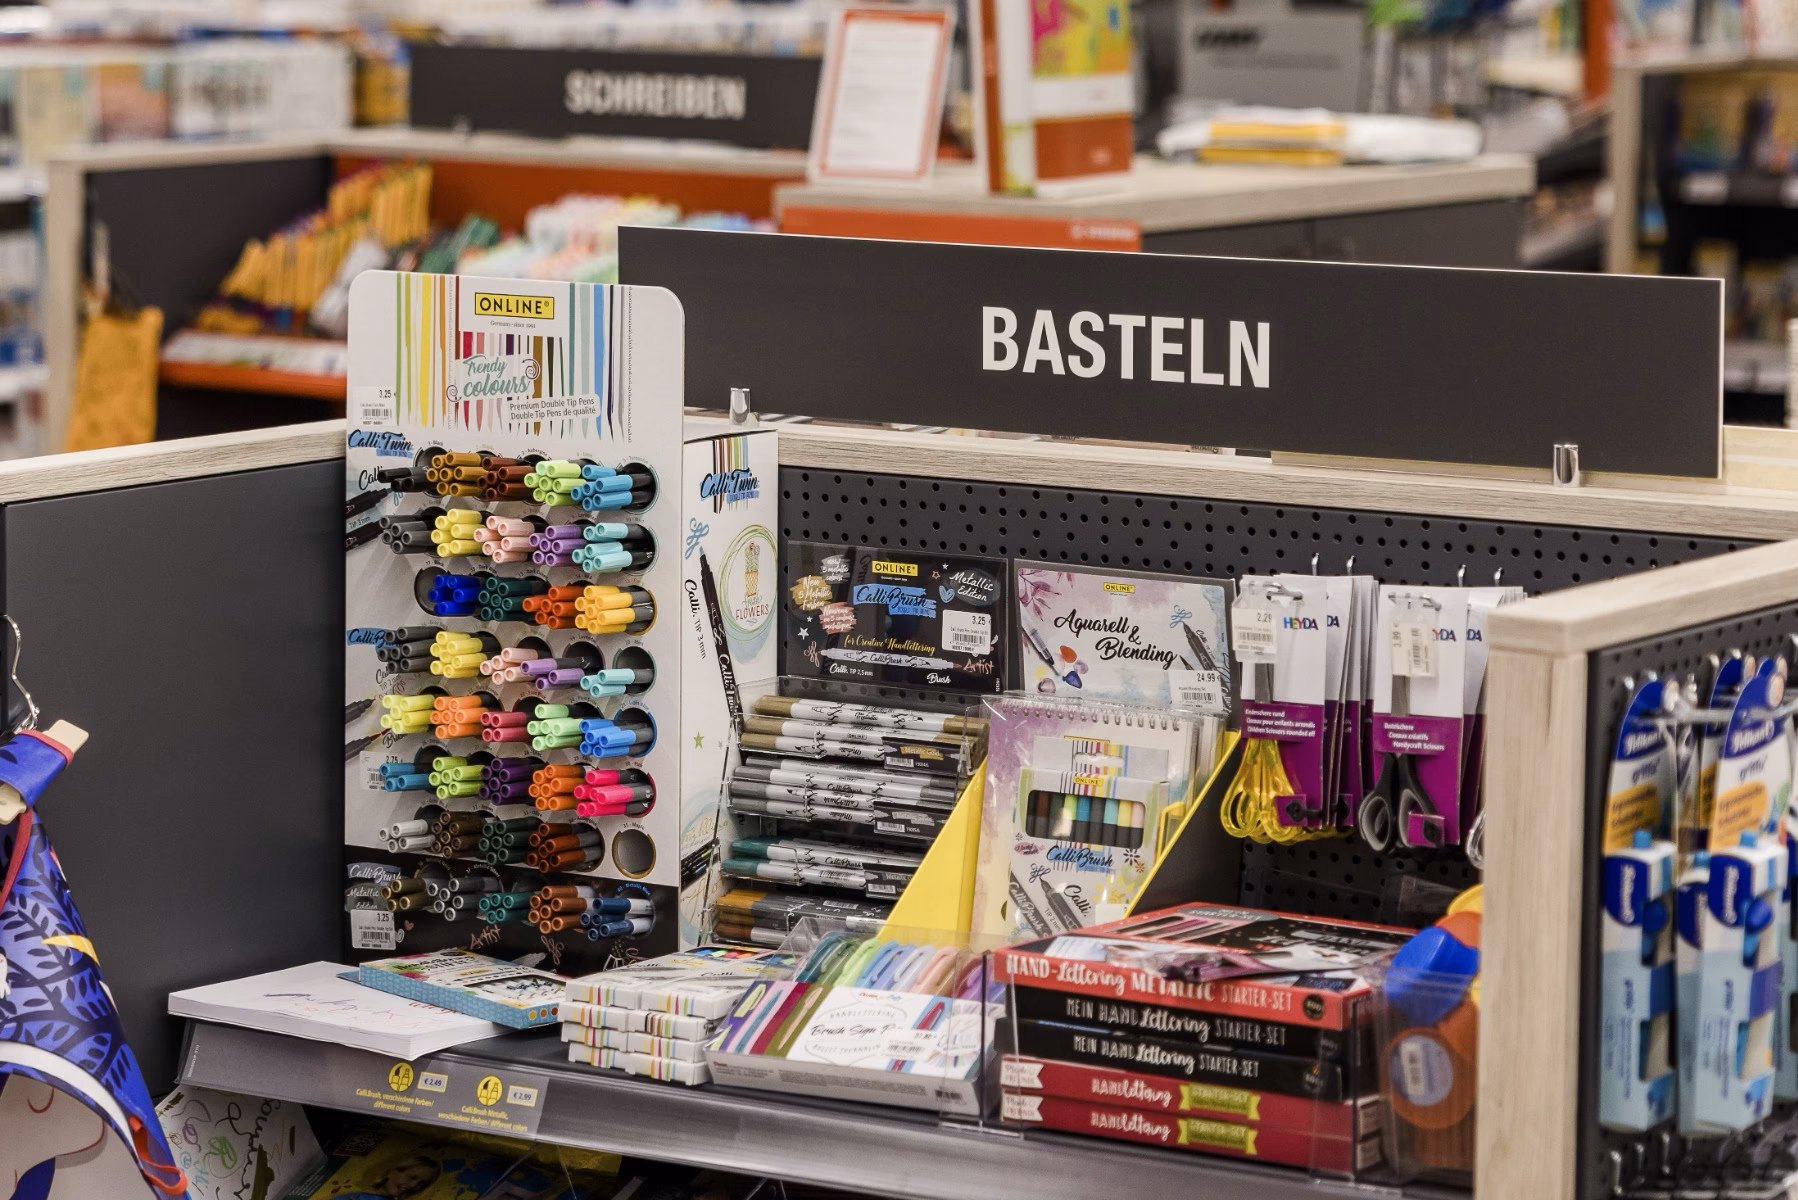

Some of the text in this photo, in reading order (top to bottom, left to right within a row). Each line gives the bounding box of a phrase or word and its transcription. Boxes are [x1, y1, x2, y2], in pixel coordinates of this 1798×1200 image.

[564, 69, 747, 121] SCHREIBEN
[982, 306, 1270, 389] BASTELN
[463, 354, 507, 378] Trendy
[463, 374, 530, 398] colours
[509, 397, 595, 411] Premium Double Tip Pens
[510, 406, 597, 421] Double Tip Pens de qualité
[802, 575, 820, 589] New
[949, 571, 994, 591] Metallic
[957, 585, 987, 602] Edition
[735, 604, 769, 621] FLOWERS
[694, 618, 702, 633] TIP
[972, 616, 986, 626] 3.25
[1054, 608, 1142, 645] Aquarell &
[1283, 616, 1319, 630] HEYDA
[844, 634, 855, 648] for
[856, 634, 884, 648] Creative
[884, 637, 936, 657] Handlettering
[1095, 636, 1178, 670] Blending
[963, 658, 995, 675] Artist
[926, 673, 951, 685] Brush
[1197, 672, 1216, 682] 24.99
[1274, 719, 1294, 728] enfants
[1423, 742, 1445, 751] Scissors
[347, 888, 380, 898] Metallic
[377, 912, 390, 922] 3.25
[470, 924, 501, 950] Artist
[1220, 983, 1293, 1011] STARTER-SET
[1066, 997, 1094, 1019] MEIN
[1215, 1018, 1287, 1046] STARTER-SET
[811, 1024, 845, 1036] Brush
[849, 1024, 877, 1038] Sign
[1073, 1034, 1097, 1054] MEIN
[1199, 1052, 1260, 1078] STARTER-SET
[374, 1102, 411, 1113] different colors
[489, 1119, 513, 1129] different
[512, 1123, 528, 1132] colors
